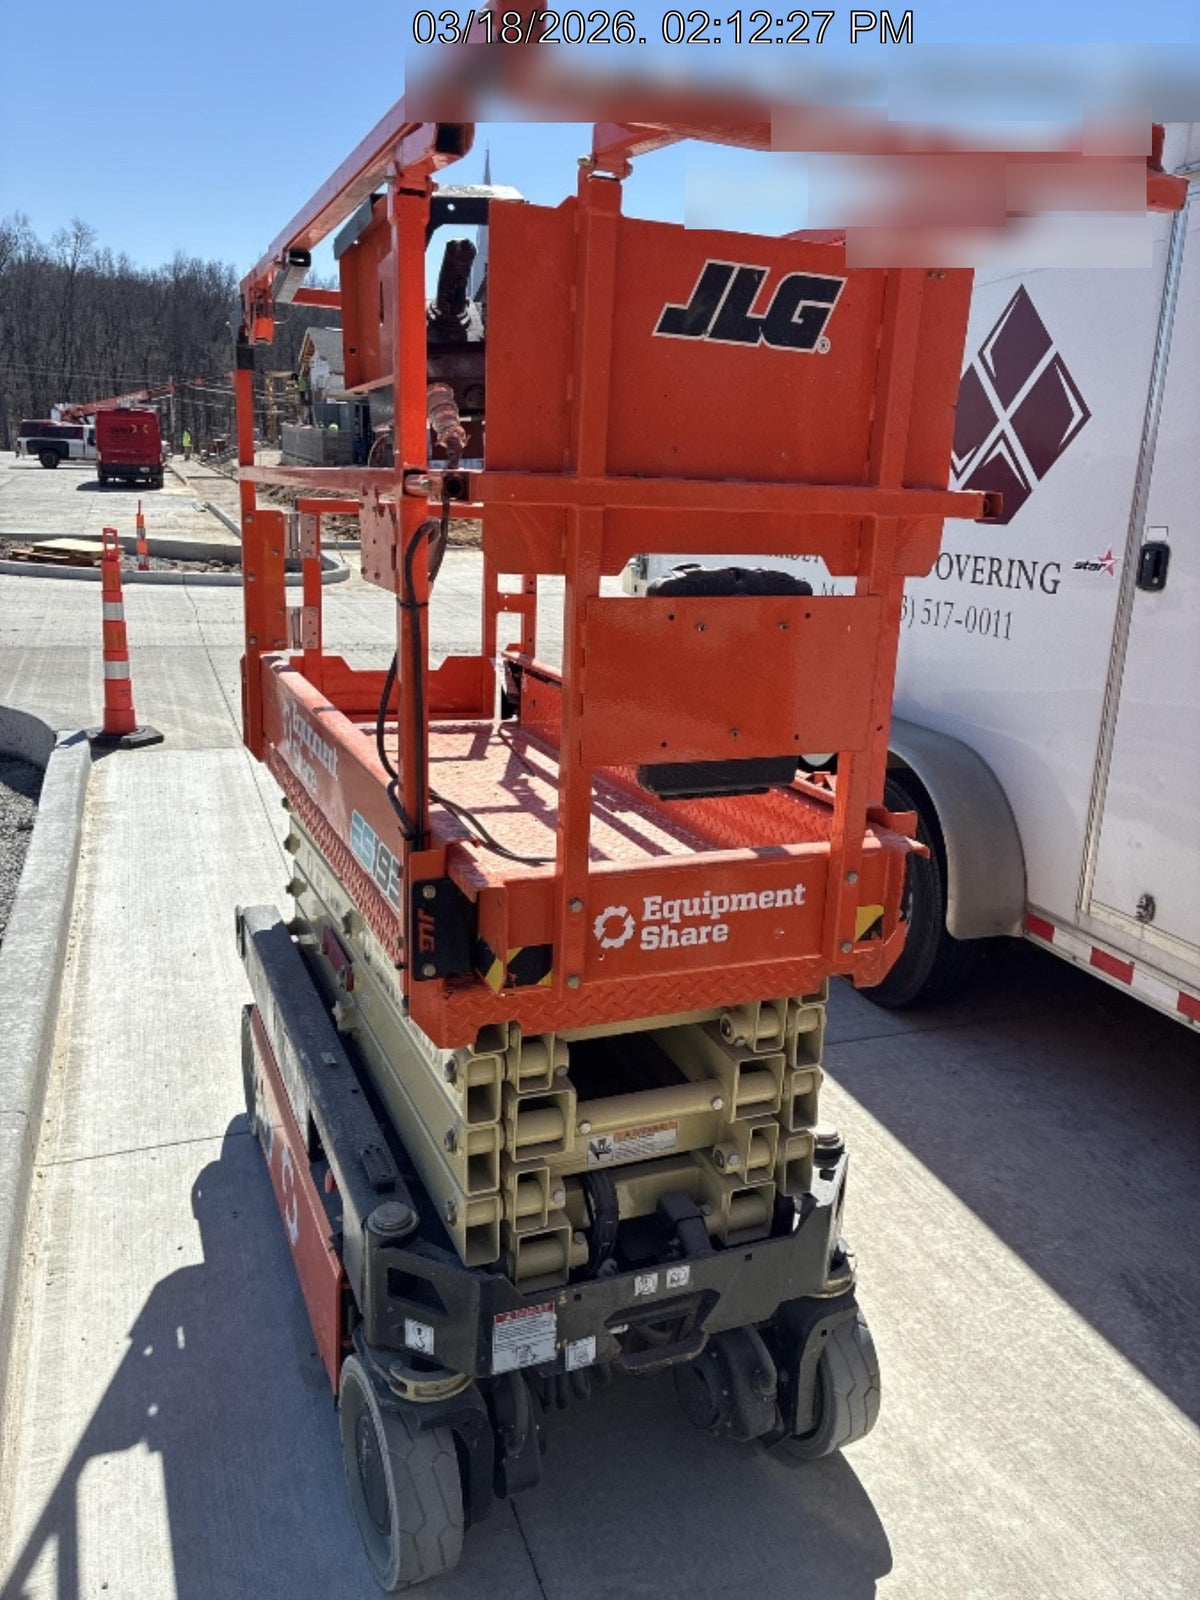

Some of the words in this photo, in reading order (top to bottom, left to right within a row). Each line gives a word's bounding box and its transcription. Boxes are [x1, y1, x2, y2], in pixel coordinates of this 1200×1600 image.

[652, 259, 848, 354] JLG
[936, 552, 1061, 594] OVERING
[920, 598, 1013, 640] 517-0011
[641, 883, 806, 923] Equipment
[640, 924, 729, 950] Share
